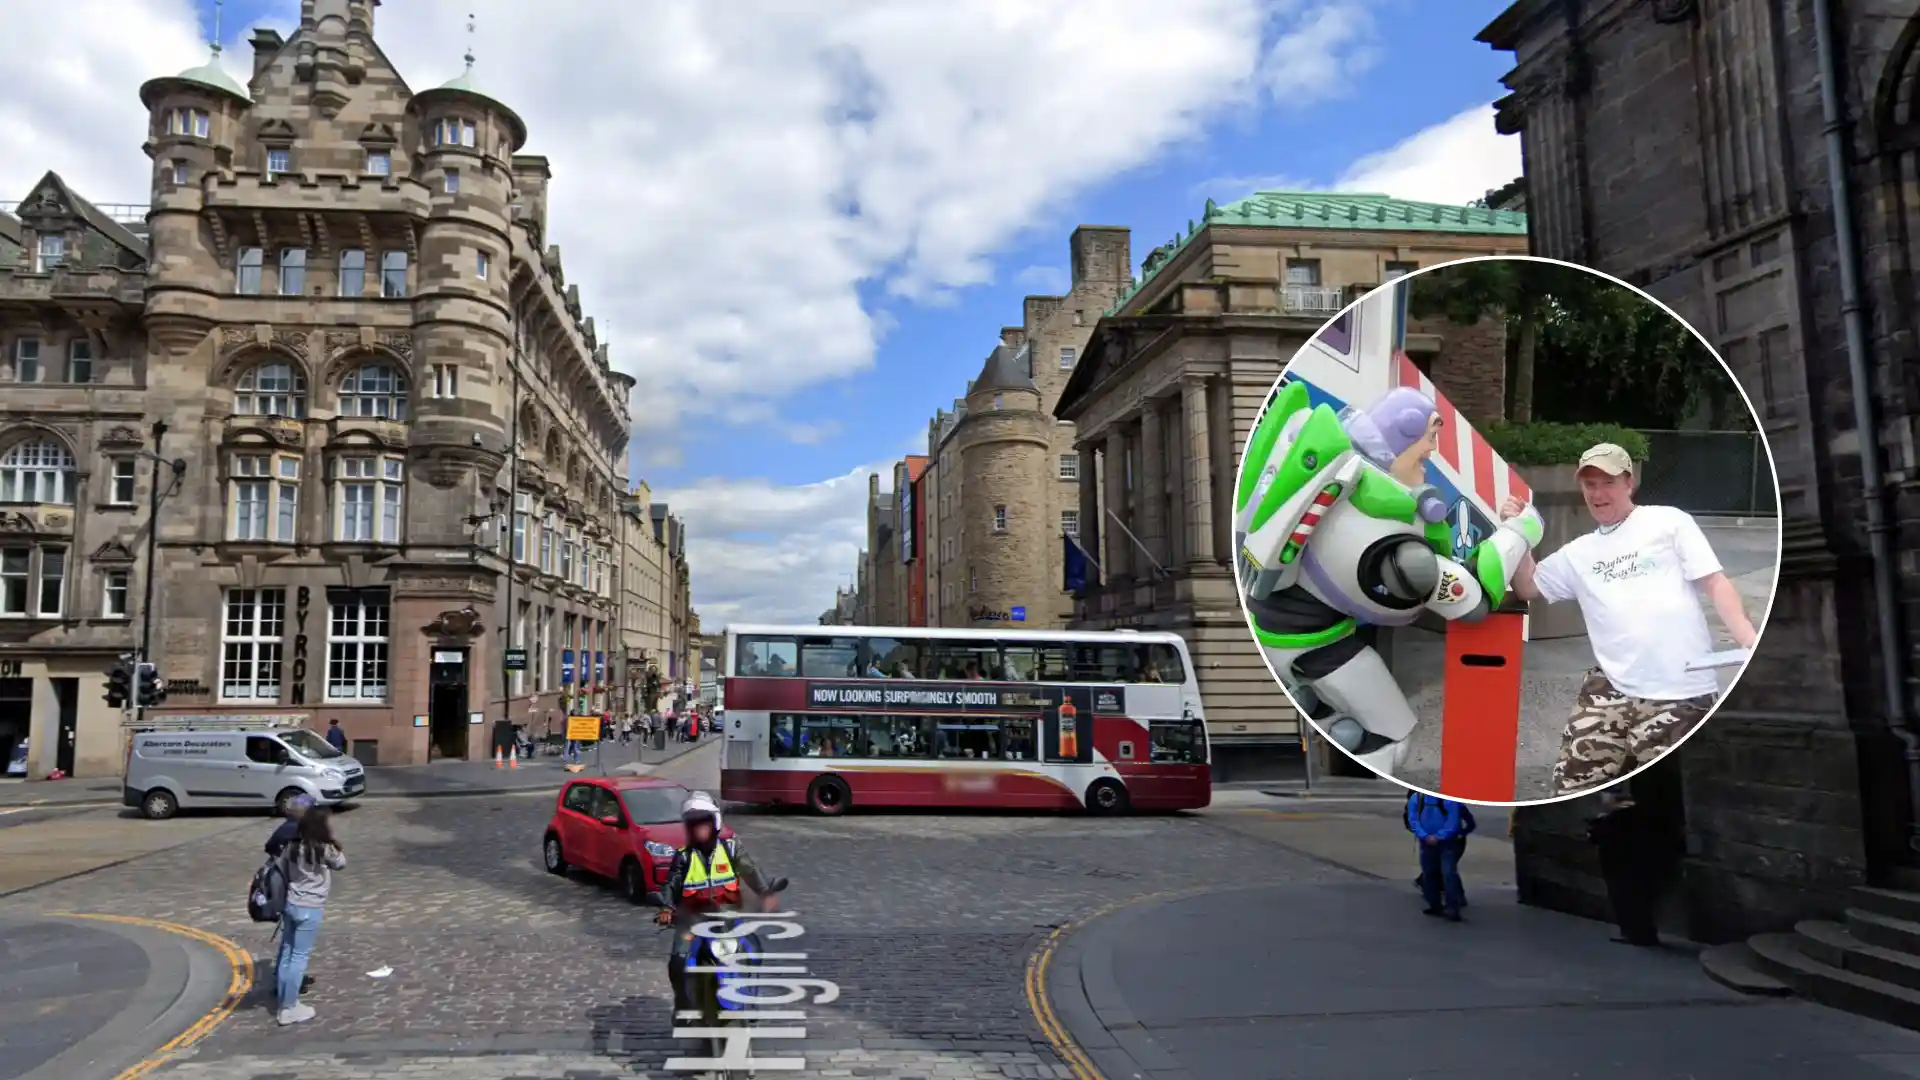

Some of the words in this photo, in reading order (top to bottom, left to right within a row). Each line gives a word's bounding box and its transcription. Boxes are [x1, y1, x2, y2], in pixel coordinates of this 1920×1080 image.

[291, 586, 310, 705] BYRON
[814, 690, 838, 702] NOW
[839, 690, 881, 702] LOOKING
[884, 690, 954, 704] SURPNGLY
[956, 692, 997, 705] SMOOTH
